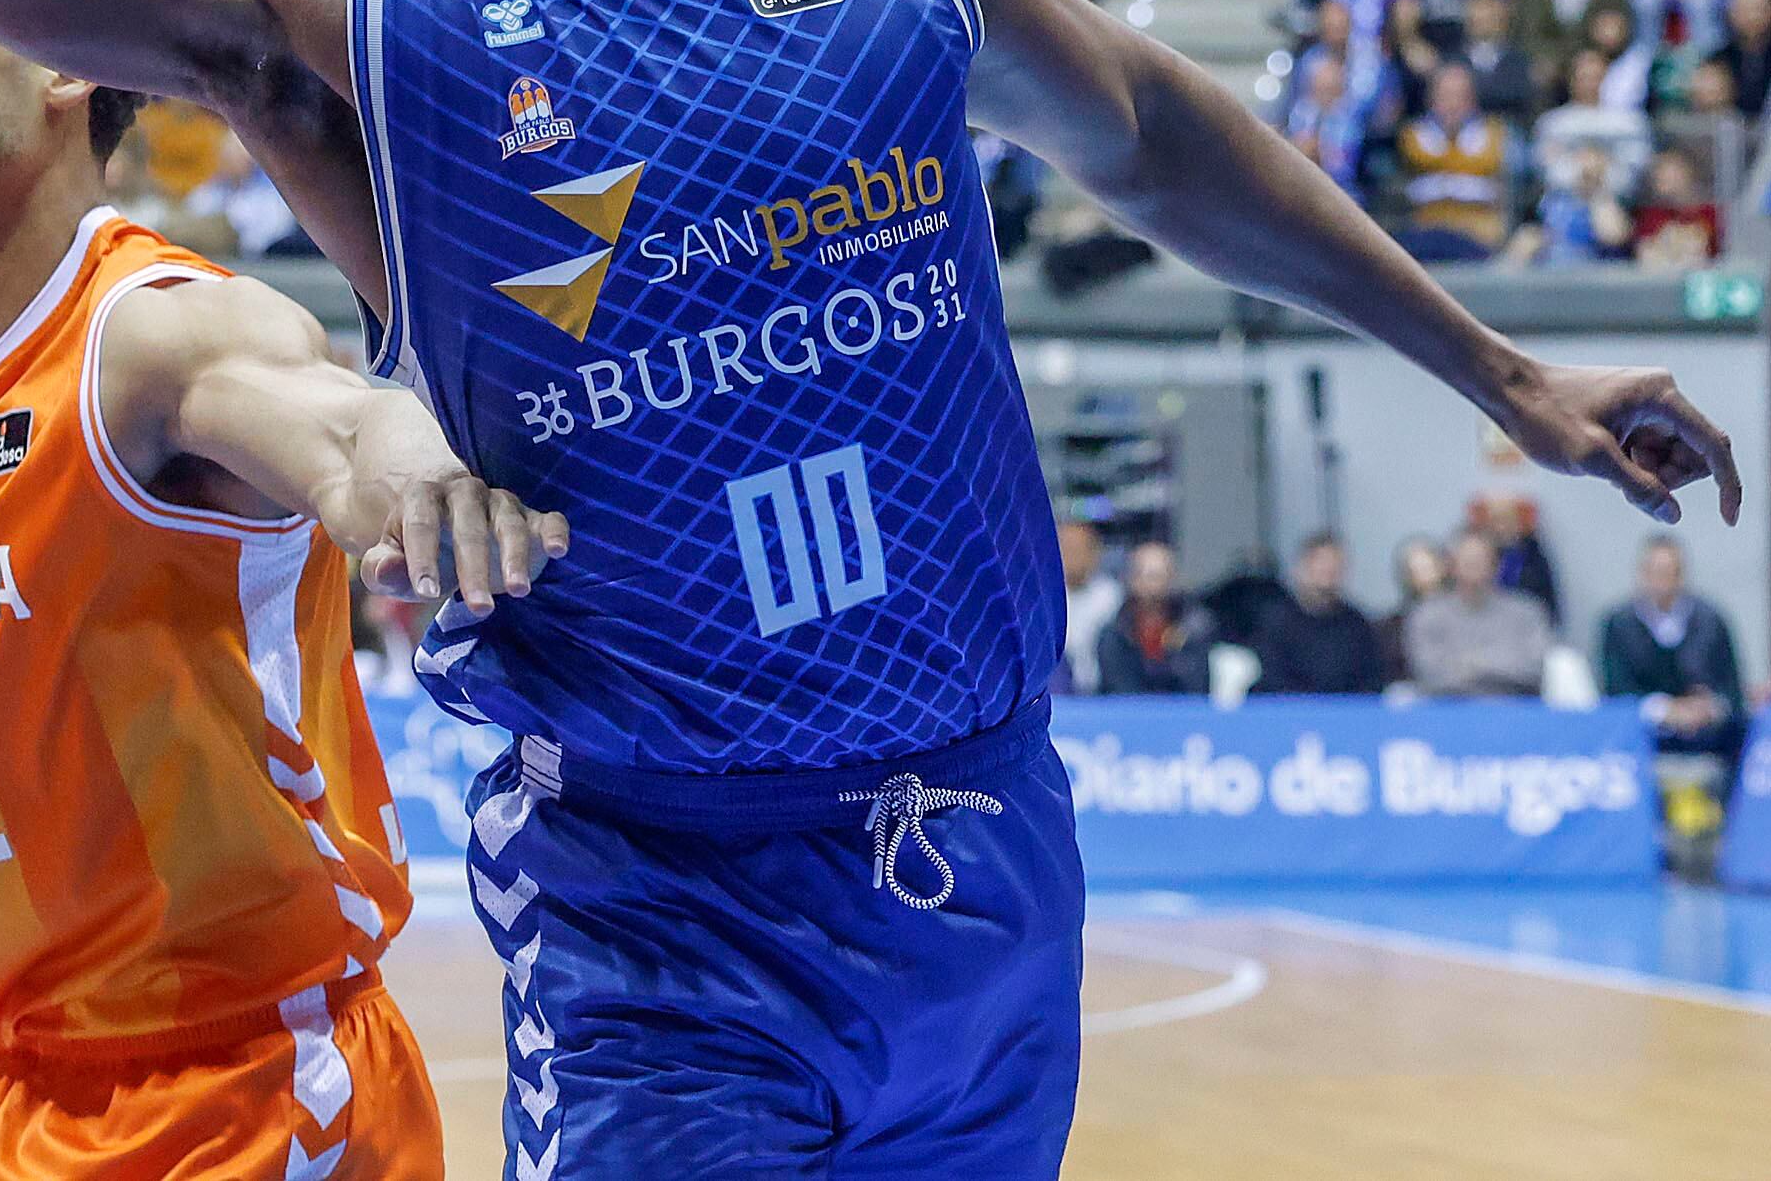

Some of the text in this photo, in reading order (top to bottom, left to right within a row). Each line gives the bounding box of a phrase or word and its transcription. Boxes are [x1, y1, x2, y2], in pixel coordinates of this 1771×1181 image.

[487, 22, 543, 46] hummel
[505, 121, 570, 152] BURGOS
[820, 211, 950, 266] INMOBILIARIA
[926, 258, 958, 295] 20
[934, 292, 967, 329] 31
[577, 272, 926, 430] BURGOS
[724, 442, 887, 639] 00
[1058, 733, 1264, 816] Diario
[1269, 731, 1370, 817] de
[1378, 737, 1639, 836] Burgos
